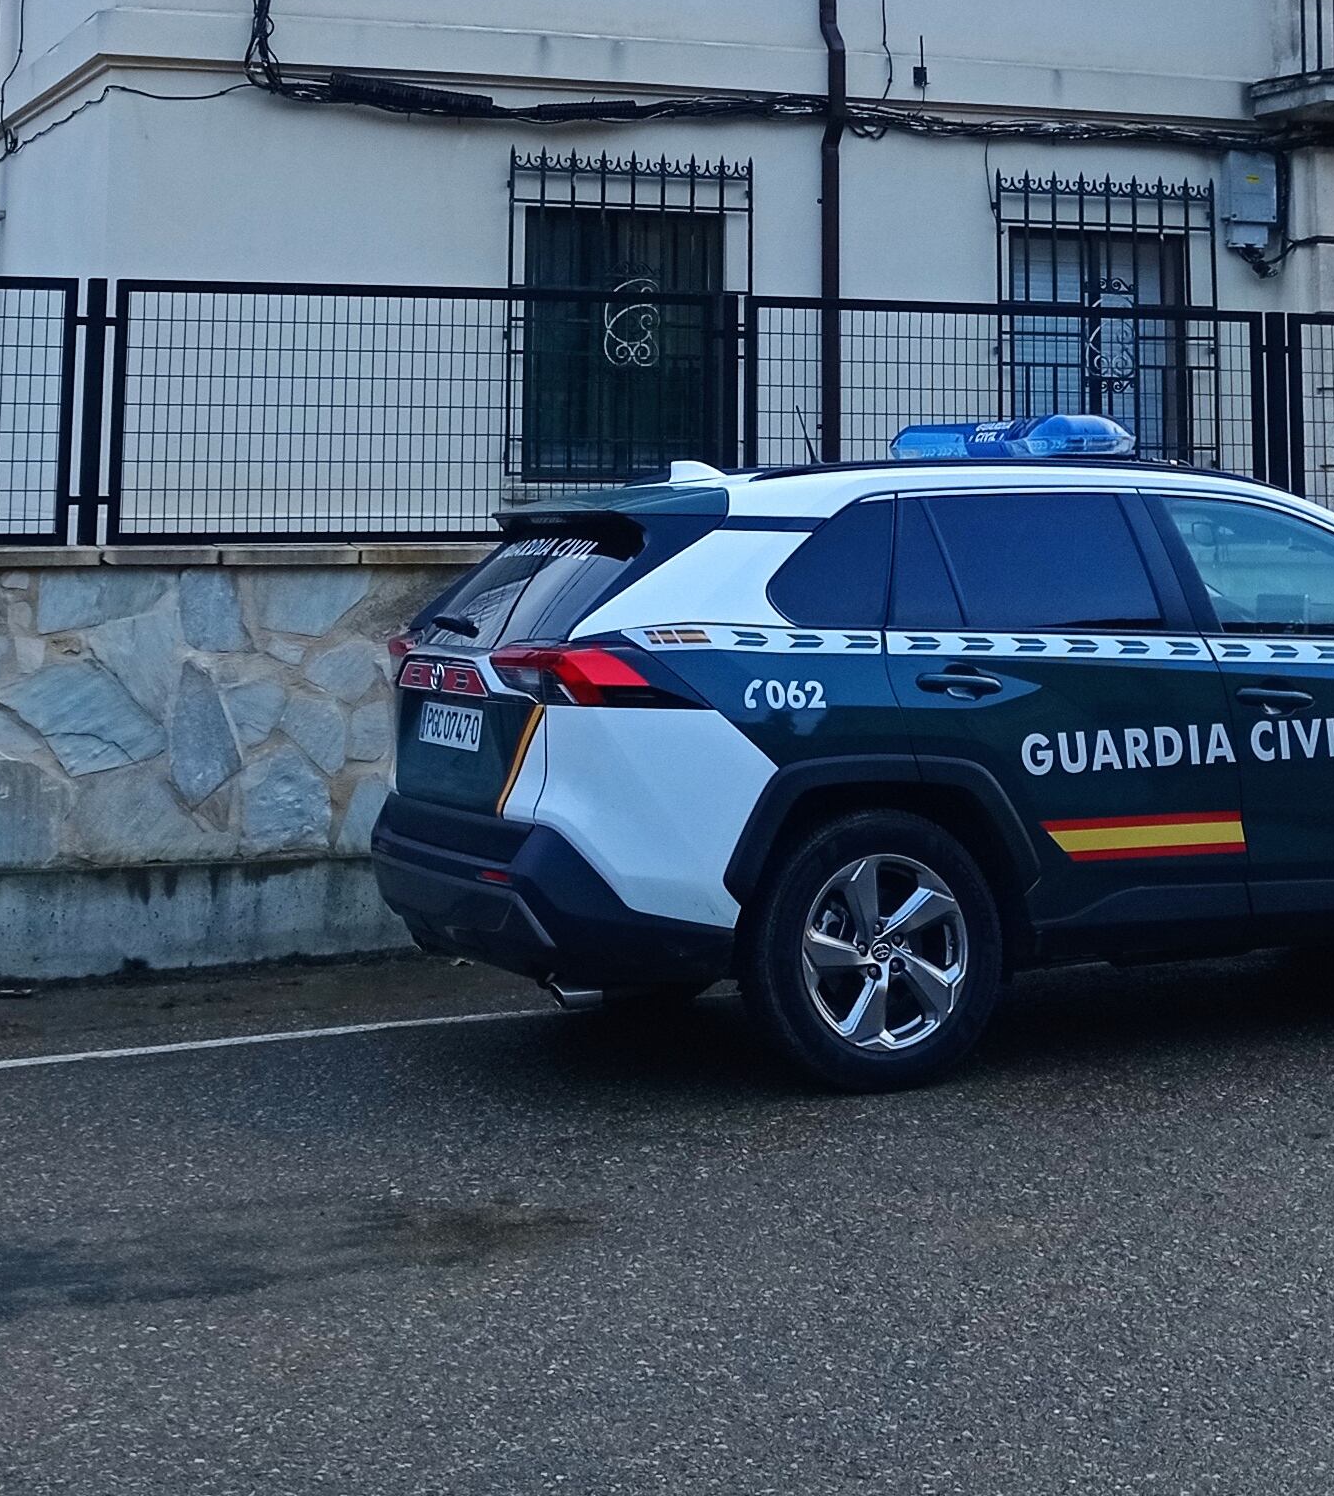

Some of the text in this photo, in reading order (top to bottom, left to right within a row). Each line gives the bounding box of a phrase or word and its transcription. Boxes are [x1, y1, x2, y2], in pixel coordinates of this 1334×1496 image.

[551, 538, 599, 561] CIVIL
[766, 679, 827, 709] 062
[1021, 723, 1237, 776] GUARDIA
